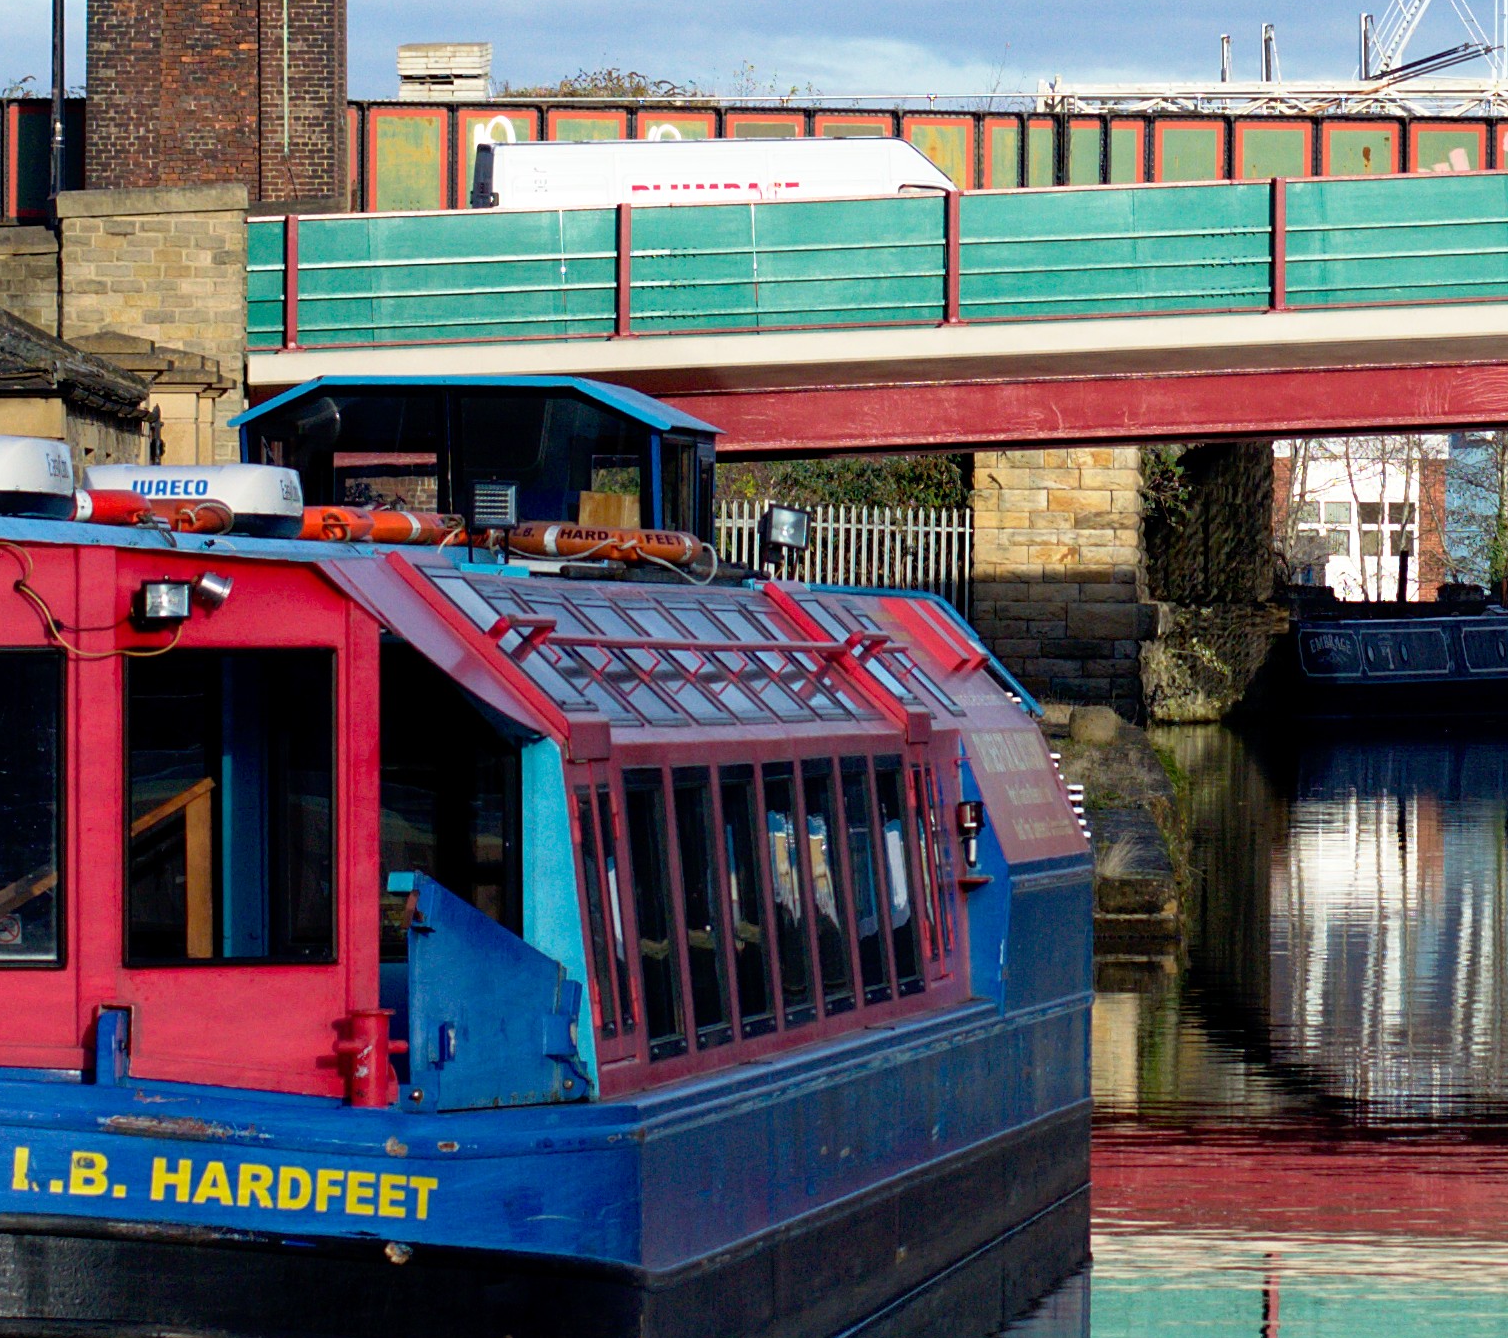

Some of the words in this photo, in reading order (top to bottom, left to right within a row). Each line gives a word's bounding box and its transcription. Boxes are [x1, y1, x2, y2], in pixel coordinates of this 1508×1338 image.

[132, 480, 209, 496] WAECO
[560, 528, 609, 541] HARD
[645, 534, 683, 546] FEET
[150, 1157, 439, 1220] HARDFEET
